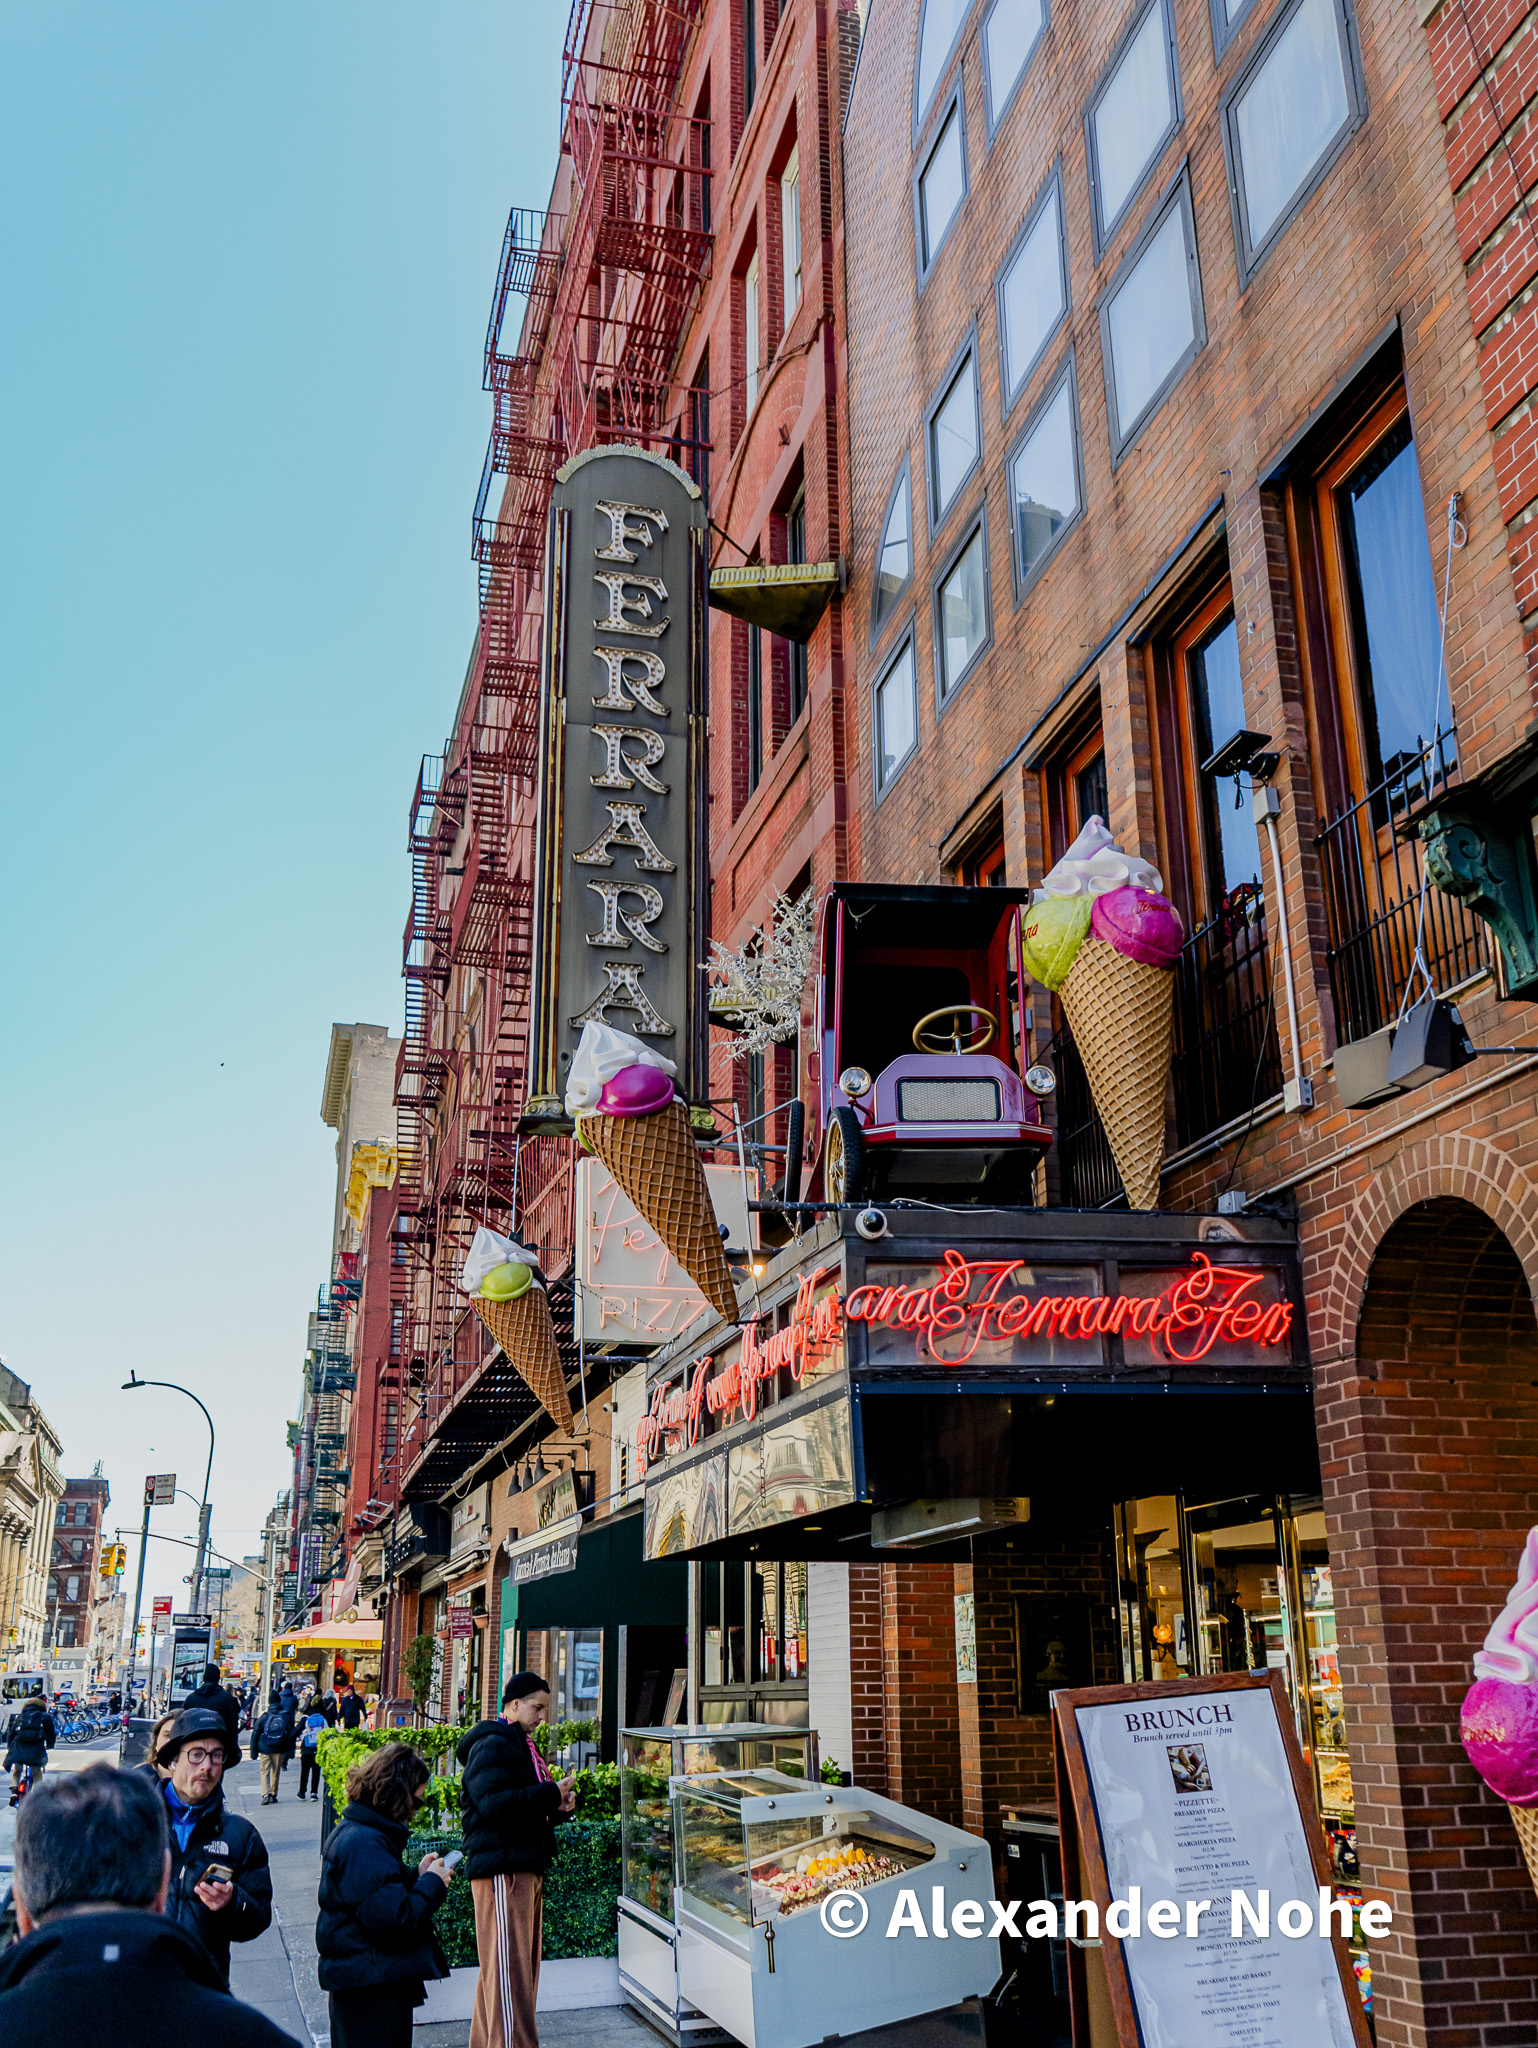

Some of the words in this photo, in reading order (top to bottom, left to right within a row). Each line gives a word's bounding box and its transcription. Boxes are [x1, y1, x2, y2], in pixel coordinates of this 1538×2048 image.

[569, 499, 677, 1036] FERRARA
[40, 1660, 77, 1670] EYTEA
[1123, 1704, 1234, 1732] BRUNCH
[1133, 1732, 1163, 1743] Brunch
[1165, 1730, 1190, 1740] served
[1192, 1727, 1212, 1737] until
[1214, 1727, 1232, 1737] 3pm
[1174, 1809, 1206, 1817] BREAKFAST
[1177, 1839, 1218, 1848] MARGHERITA
[1174, 1863, 1215, 1874] PROSCIUTTO
[1196, 1941, 1238, 1952] PROSCIUTTO
[1238, 1938, 1263, 1946] PANINI
[1197, 1976, 1228, 1985] BREAKFAST
[1229, 1973, 1250, 1981] BREAD
[1250, 1971, 1272, 1979] BASKET
[1201, 2006, 1236, 2015] PANETTONE
[1229, 2027, 1262, 2036] OMELETTE
